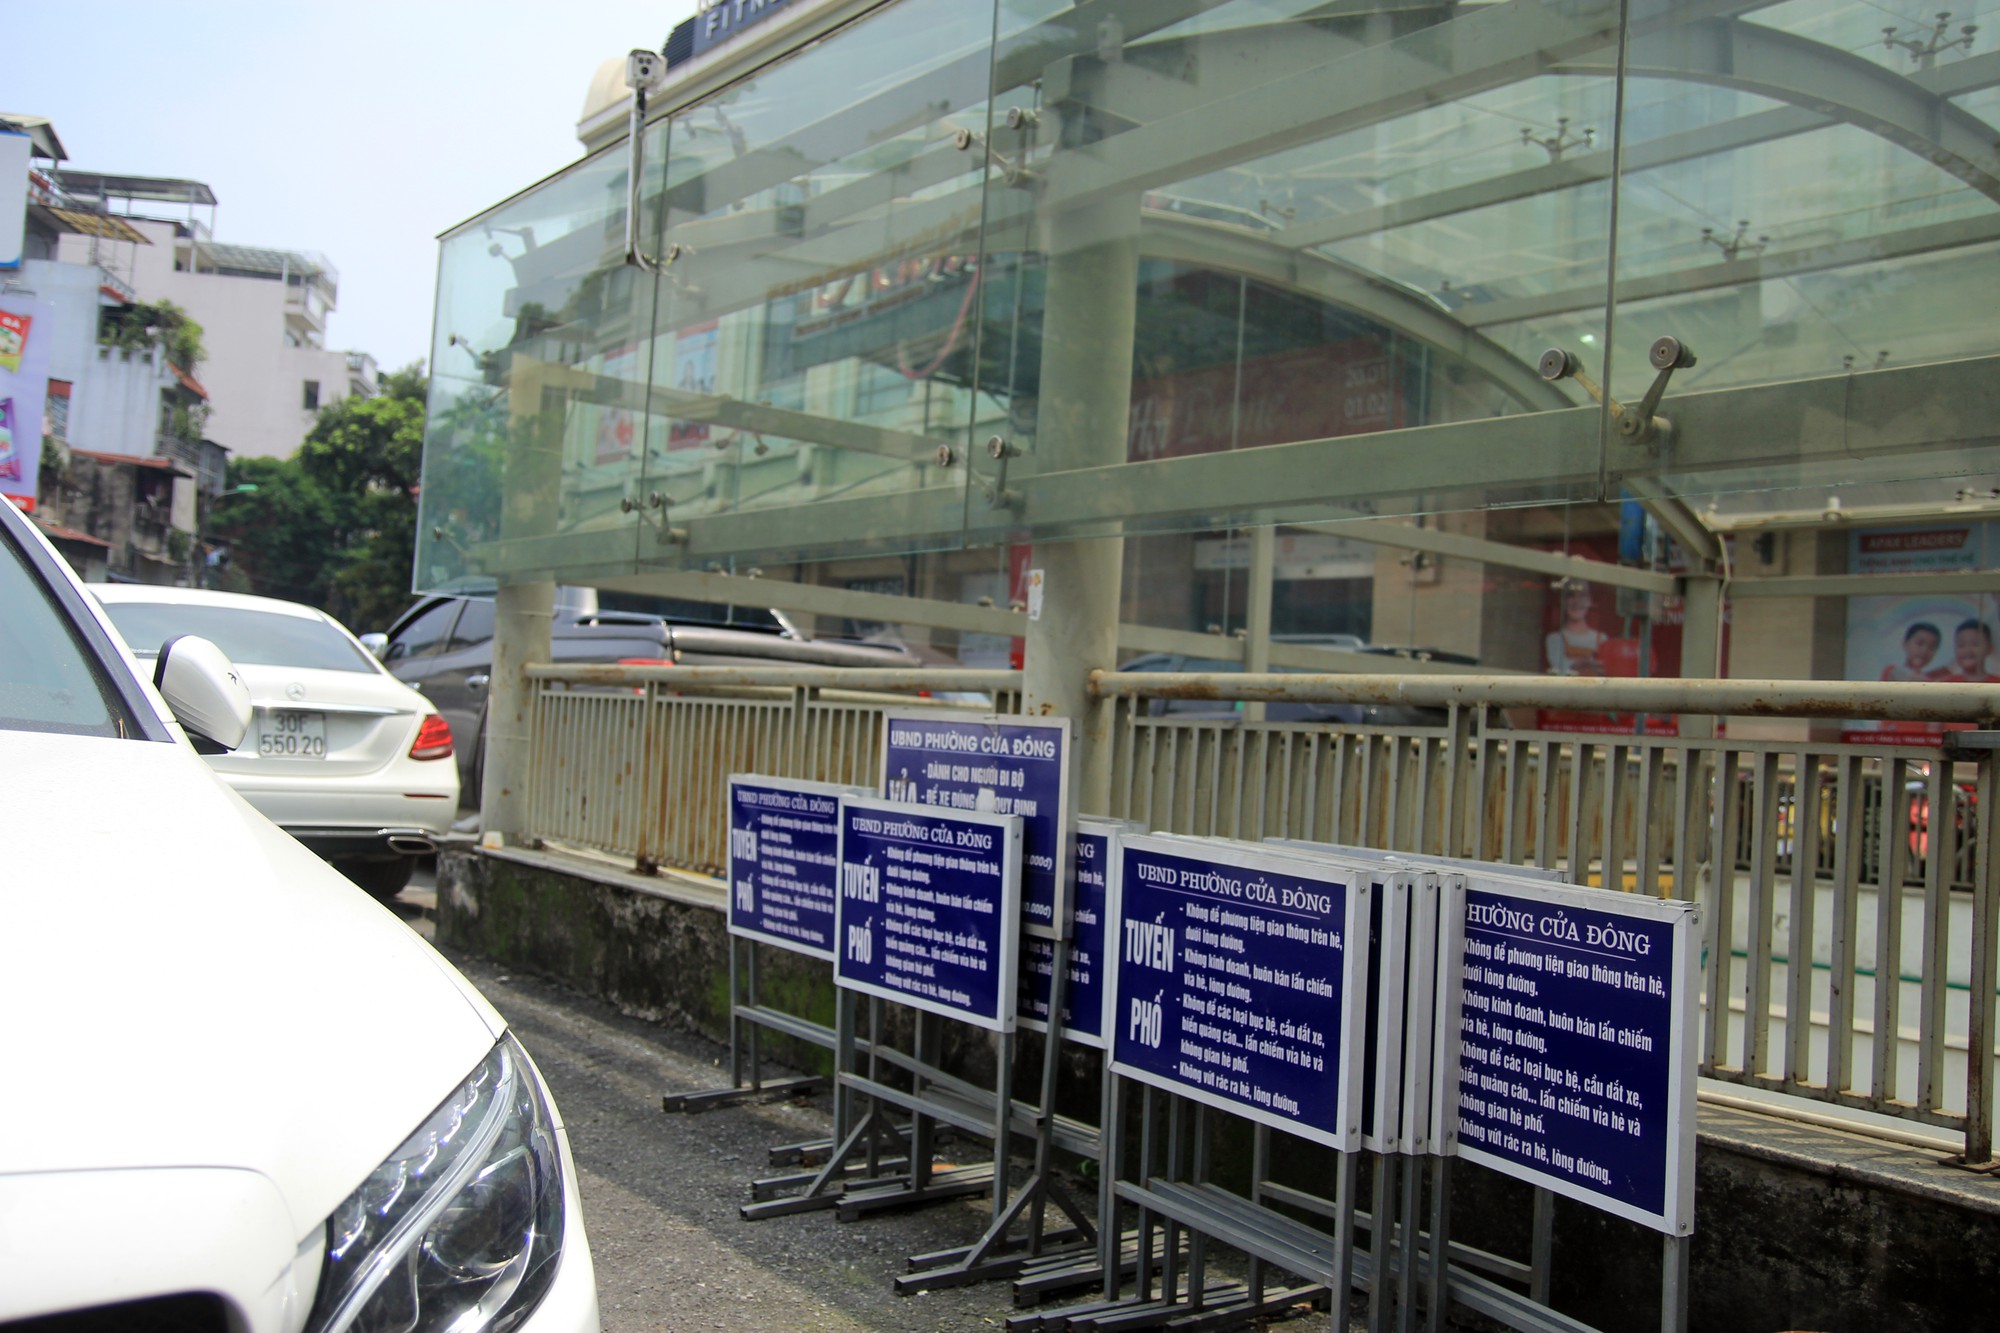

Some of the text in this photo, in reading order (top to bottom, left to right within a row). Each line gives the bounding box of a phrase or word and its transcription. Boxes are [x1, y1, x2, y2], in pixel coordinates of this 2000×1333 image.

[275, 714, 307, 733] 30F
[891, 730, 922, 747] UBND
[925, 730, 978, 753] PHƯỜNG
[1013, 735, 1056, 757] ĐÔNG
[926, 784, 939, 805] ĐỂ
[939, 790, 950, 806] XE
[951, 790, 975, 810] ĐÚNG
[927, 761, 1024, 791] DÀNH CHO NGƯỜI ĐI BỘ
[852, 817, 882, 833] UBND
[883, 820, 928, 840] PHƯỜNG
[931, 824, 954, 844] CỬA
[957, 829, 992, 849] ĐÔNG
[844, 855, 879, 903] TUYẾN
[1138, 863, 1331, 914] UBND PHƯỜNG CỬA ĐÔNG
[848, 916, 872, 964] PHỐ
[1126, 912, 1174, 972] TUYẾN
[1540, 911, 1580, 941] CỬA
[1586, 922, 1650, 955] ĐÔNG
[1484, 968, 1504, 989] lòng
[1507, 974, 1538, 996] đường.
[1494, 942, 1506, 961] để
[1508, 948, 1542, 971] phương
[1545, 955, 1564, 976] tiện
[1567, 960, 1589, 979] giao
[1592, 964, 1621, 988] thông
[1624, 971, 1645, 991] trên
[1649, 976, 1665, 998] hè,
[1130, 989, 1163, 1048] PHỐ
[1476, 1018, 1490, 1038] hè,
[1493, 1022, 1512, 1045] lòng
[1516, 1029, 1547, 1053] đường.
[1492, 996, 1512, 1016] kinh
[1515, 1002, 1546, 1026] doanh,
[1549, 1010, 1573, 1032] buôn
[1577, 1017, 1595, 1037] bán
[1599, 1020, 1614, 1042] lấn
[1618, 1028, 1652, 1051] chiếm
[1490, 1047, 1502, 1066] để
[1504, 1054, 1521, 1072] các
[1524, 1058, 1542, 1080] loại
[1545, 1064, 1562, 1086] bục
[1566, 1070, 1580, 1092] bệ,
[1584, 1074, 1603, 1096] cầu
[1606, 1080, 1623, 1102] dắt
[1626, 1090, 1642, 1110] xe,
[1481, 1074, 1508, 1097] quảng
[1511, 1083, 1536, 1104] cáo...
[1540, 1089, 1555, 1110] lấn
[1558, 1097, 1589, 1120] chiếm
[1593, 1105, 1608, 1126] vỉa
[1612, 1111, 1624, 1131] hè
[1628, 1118, 1640, 1136] và
[1488, 1102, 1507, 1121] gian
[1510, 1107, 1522, 1126] hè
[1524, 1114, 1545, 1134] phố.
[1488, 1128, 1501, 1146] vứt
[1504, 1134, 1519, 1152] rác
[1522, 1141, 1531, 1156] ra
[1534, 1142, 1549, 1164] hè,
[1552, 1148, 1574, 1173] lòng
[1577, 1158, 1611, 1185] đường.
